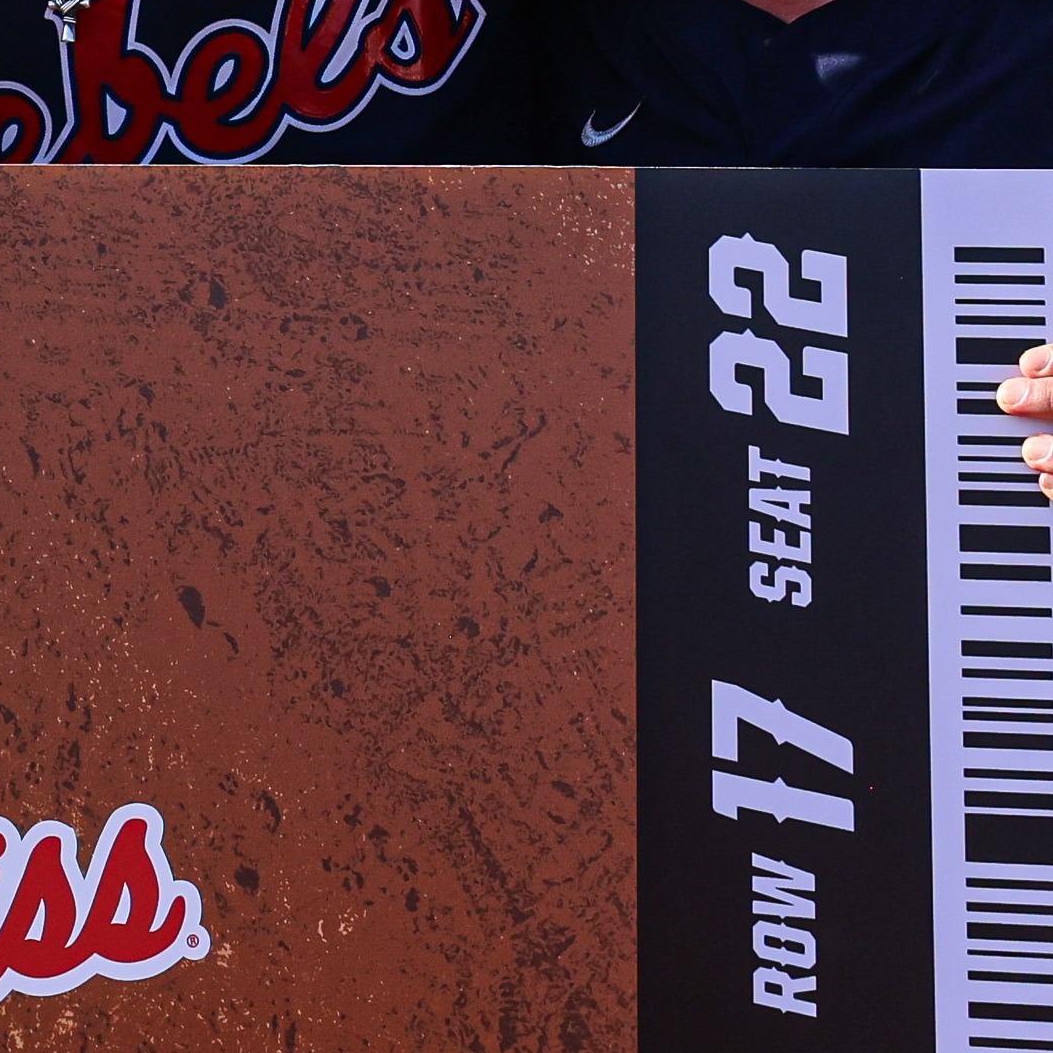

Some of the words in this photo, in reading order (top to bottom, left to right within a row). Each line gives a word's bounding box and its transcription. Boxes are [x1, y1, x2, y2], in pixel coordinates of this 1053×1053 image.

[708, 232, 850, 436] 22
[749, 446, 813, 608] SEAT
[711, 679, 855, 832] 17
[751, 852, 818, 1018] ROW
